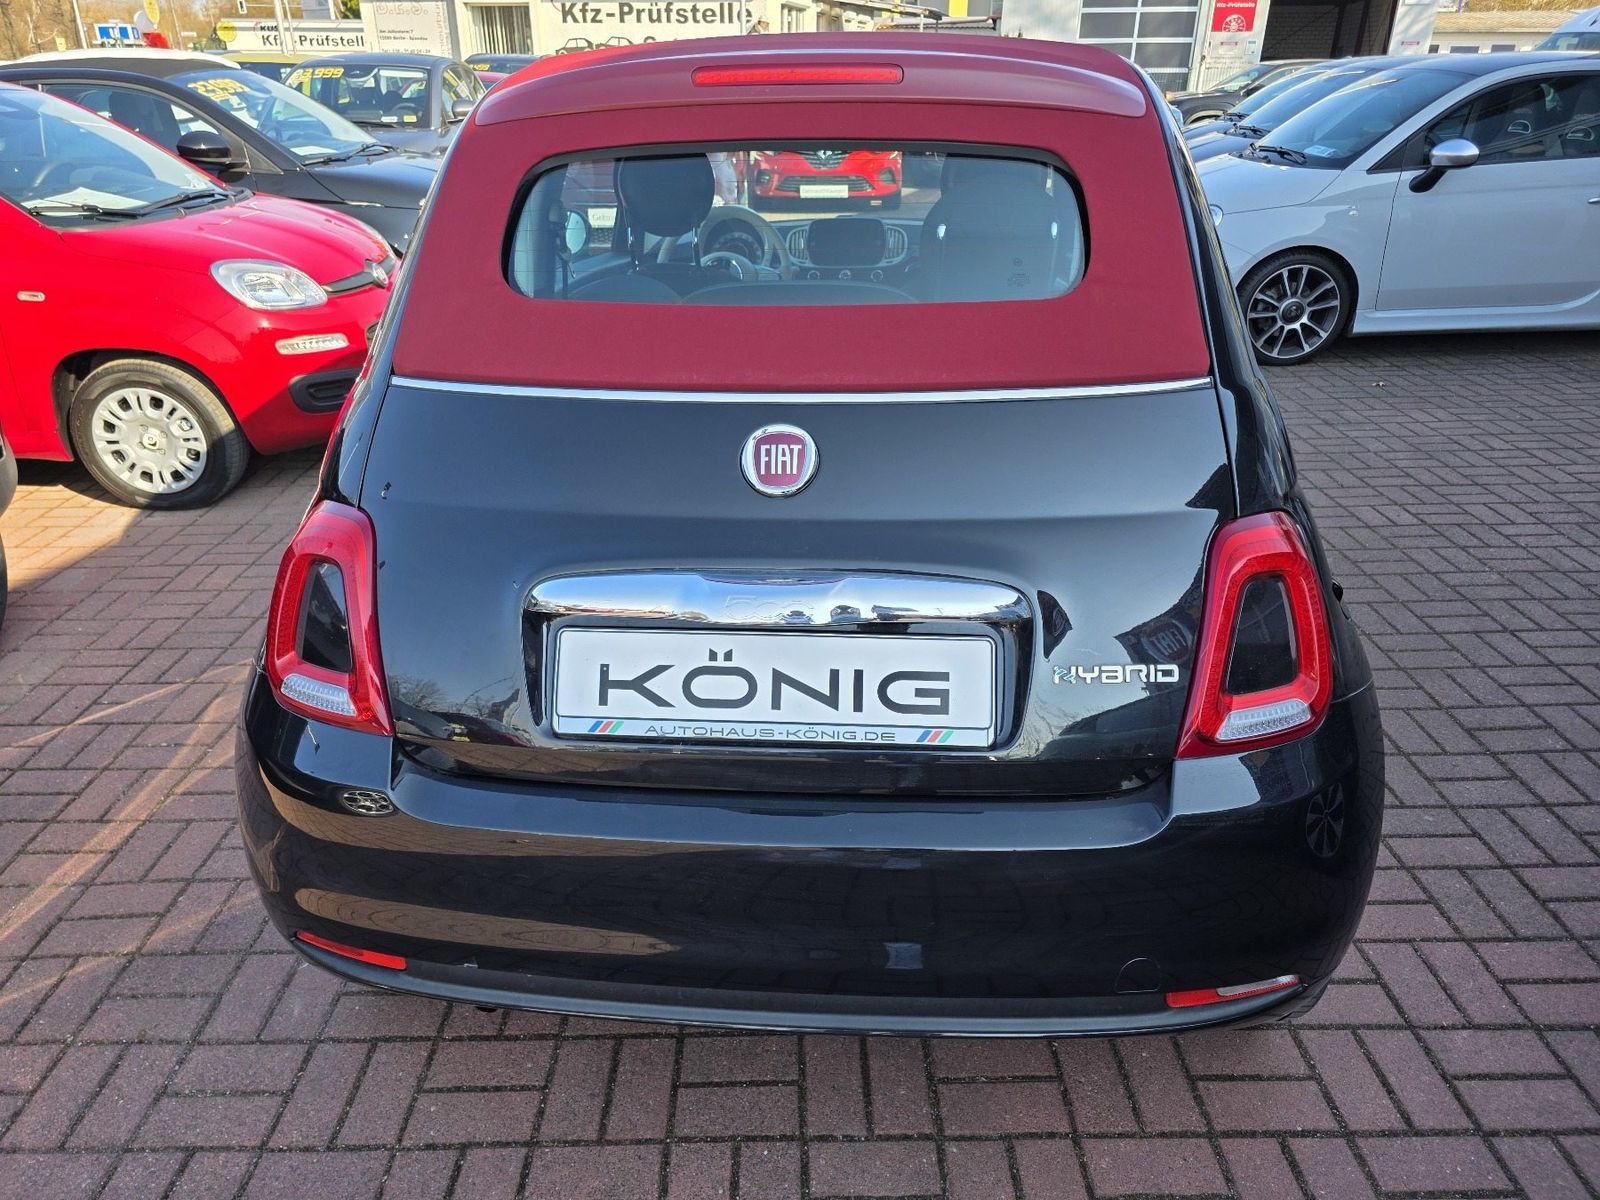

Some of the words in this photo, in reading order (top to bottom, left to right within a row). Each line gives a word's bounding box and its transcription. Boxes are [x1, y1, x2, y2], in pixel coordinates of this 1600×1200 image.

[560, 1, 753, 24] Kfz-Prüfstelle
[760, 444, 802, 475] FIAT
[598, 647, 951, 715] KÖNIG
[1053, 663, 1180, 684] HYBRID
[644, 725, 897, 742] AUTOHAUS-KÖNIG.DE
